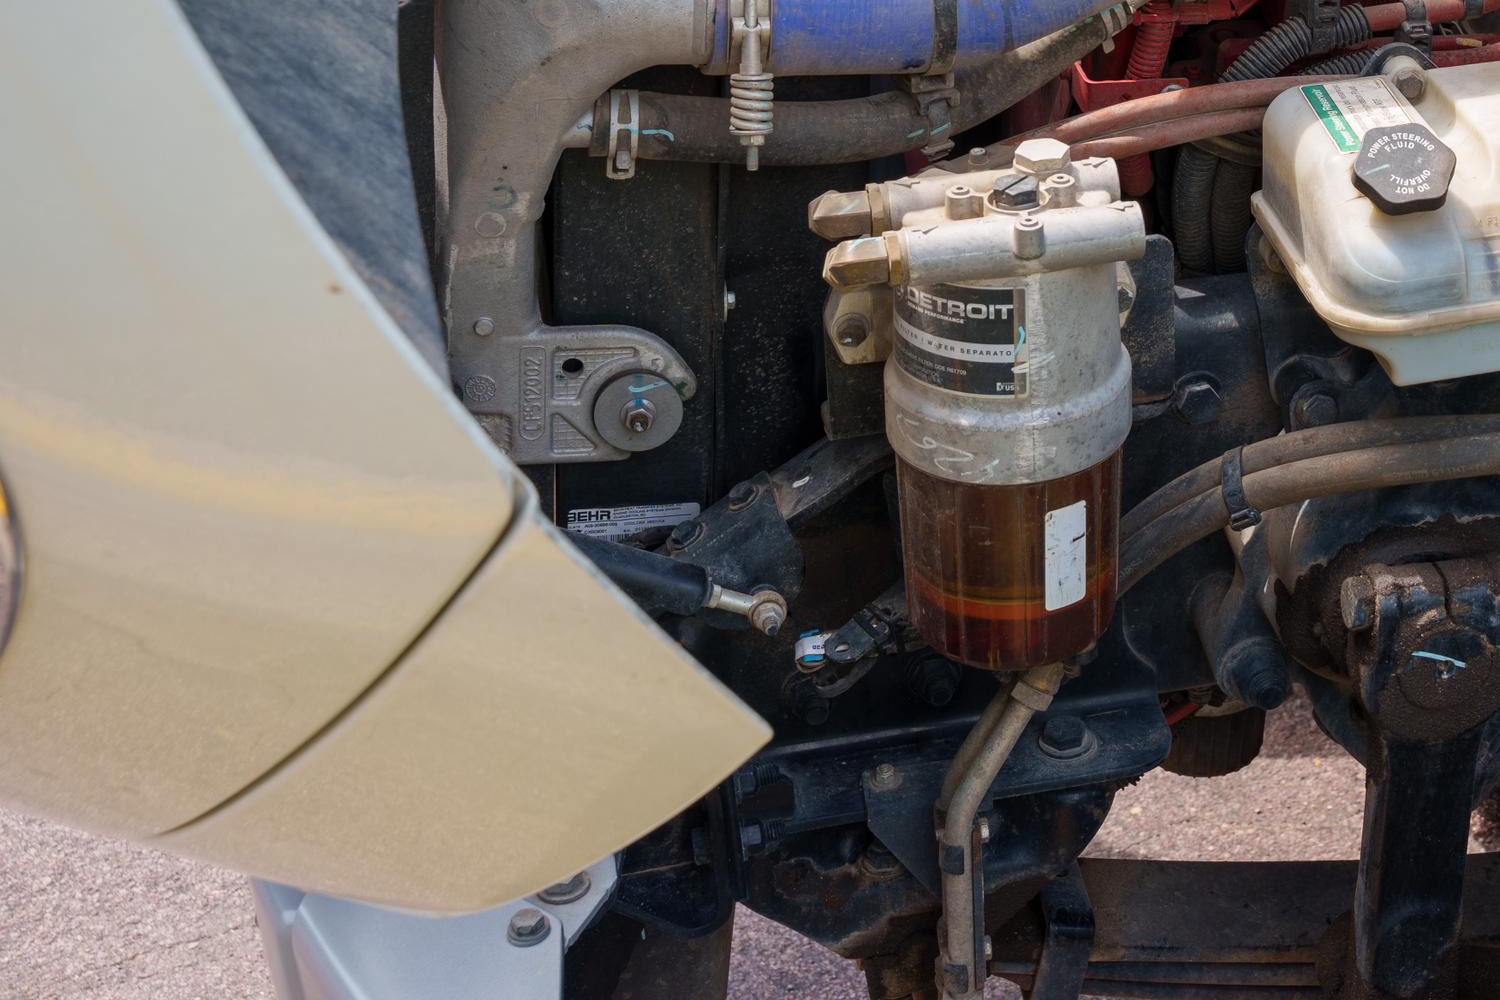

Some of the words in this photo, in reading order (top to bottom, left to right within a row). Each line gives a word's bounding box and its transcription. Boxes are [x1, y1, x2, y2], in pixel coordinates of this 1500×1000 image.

[1368, 135, 1391, 158] POWER
[1391, 132, 1435, 151] STEERING
[1384, 140, 1415, 152] FLUID
[1388, 169, 1432, 186] OVERFILL
[1395, 186, 1415, 195] NOT
[1417, 182, 1431, 193] DO
[907, 285, 1014, 320] DETROIT
[924, 308, 965, 324] PERFORMANCE
[960, 347, 1013, 357] SEPARATO
[568, 510, 611, 522] BEHR
